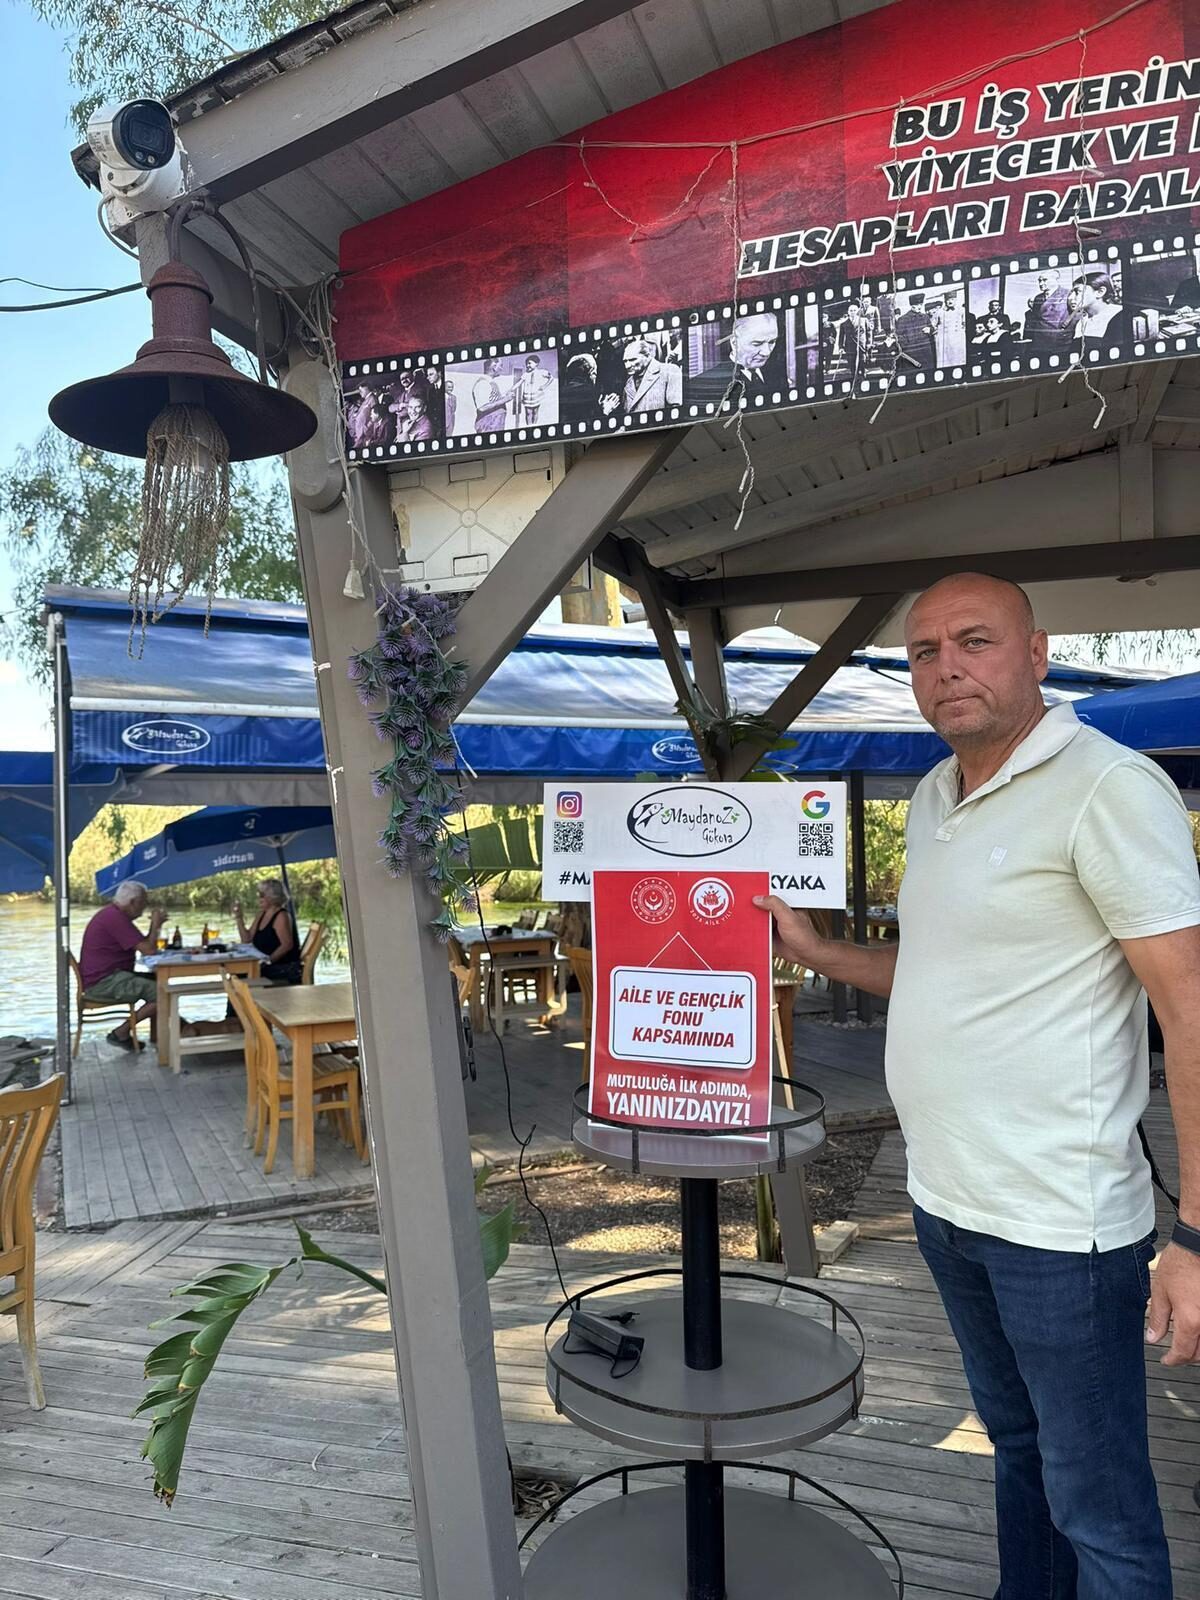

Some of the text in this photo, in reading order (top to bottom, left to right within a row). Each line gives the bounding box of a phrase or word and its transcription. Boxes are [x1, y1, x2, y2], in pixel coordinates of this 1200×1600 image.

[891, 55, 1200, 147] BU İŞ YERİN
[884, 131, 1102, 200] YİYECEK
[1105, 116, 1179, 165] VE
[739, 168, 1200, 279] HESAPLARI BABAL
[702, 827, 734, 844] Gökova
[618, 985, 746, 1012] AİLE VE GENÇLİK
[662, 1010, 704, 1027] FONU
[631, 1027, 735, 1047] KAPSAMINDA
[606, 1073, 752, 1100] MUTLULUĞA İLK ADIMDA,
[606, 1091, 751, 1126] YANINIZDAYIZ!
